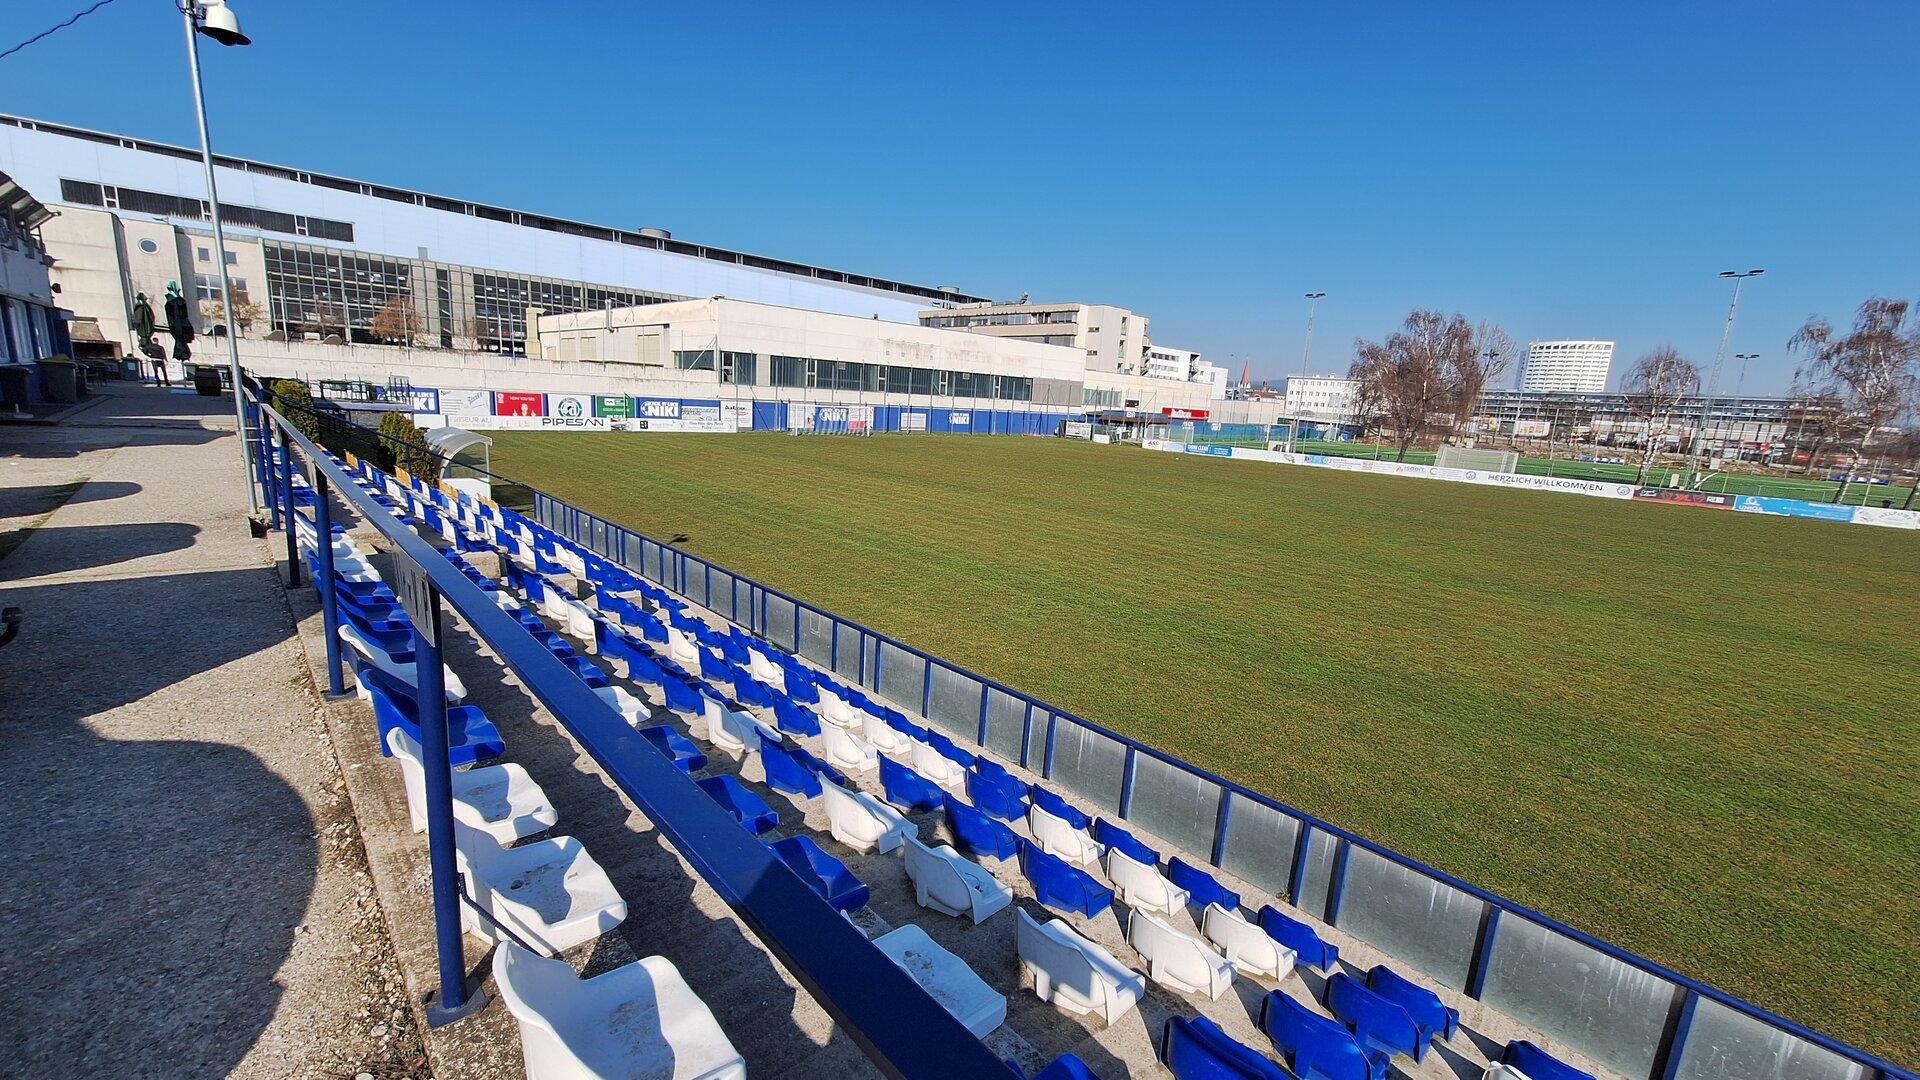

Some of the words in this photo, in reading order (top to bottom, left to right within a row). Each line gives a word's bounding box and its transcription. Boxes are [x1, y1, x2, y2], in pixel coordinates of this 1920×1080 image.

[647, 405, 679, 416] NIKI
[823, 410, 847, 421] NIKI
[542, 418, 604, 427] PIPESAN
[952, 416, 969, 425] NIKI
[1487, 474, 1532, 484] HERZLICH
